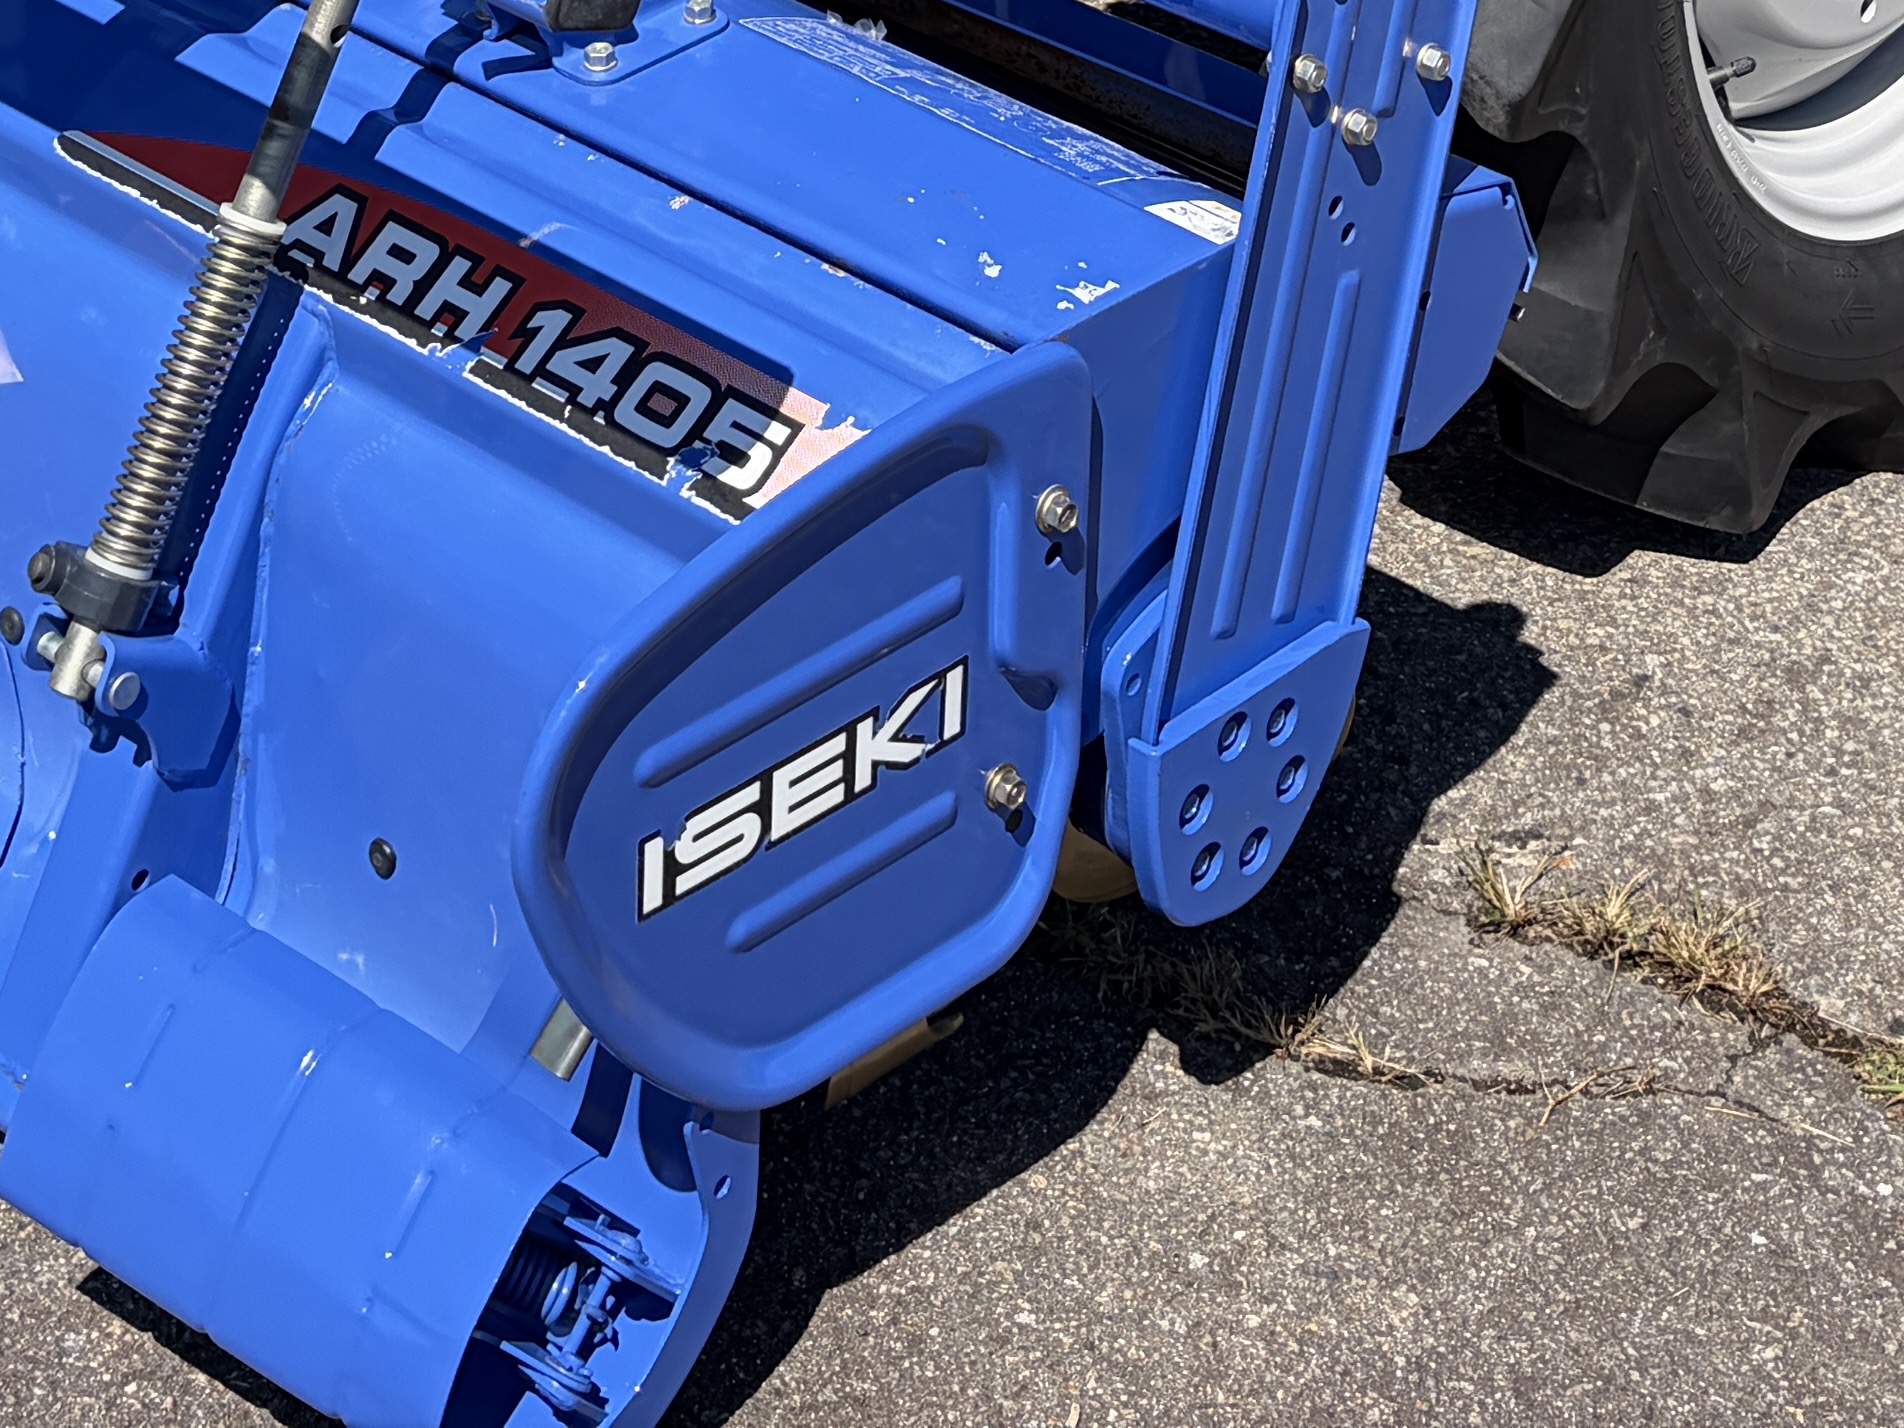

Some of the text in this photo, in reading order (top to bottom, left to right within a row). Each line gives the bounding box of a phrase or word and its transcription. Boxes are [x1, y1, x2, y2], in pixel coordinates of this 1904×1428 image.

[280, 188, 800, 494] ARH 1405
[636, 655, 968, 922] ISEKI
